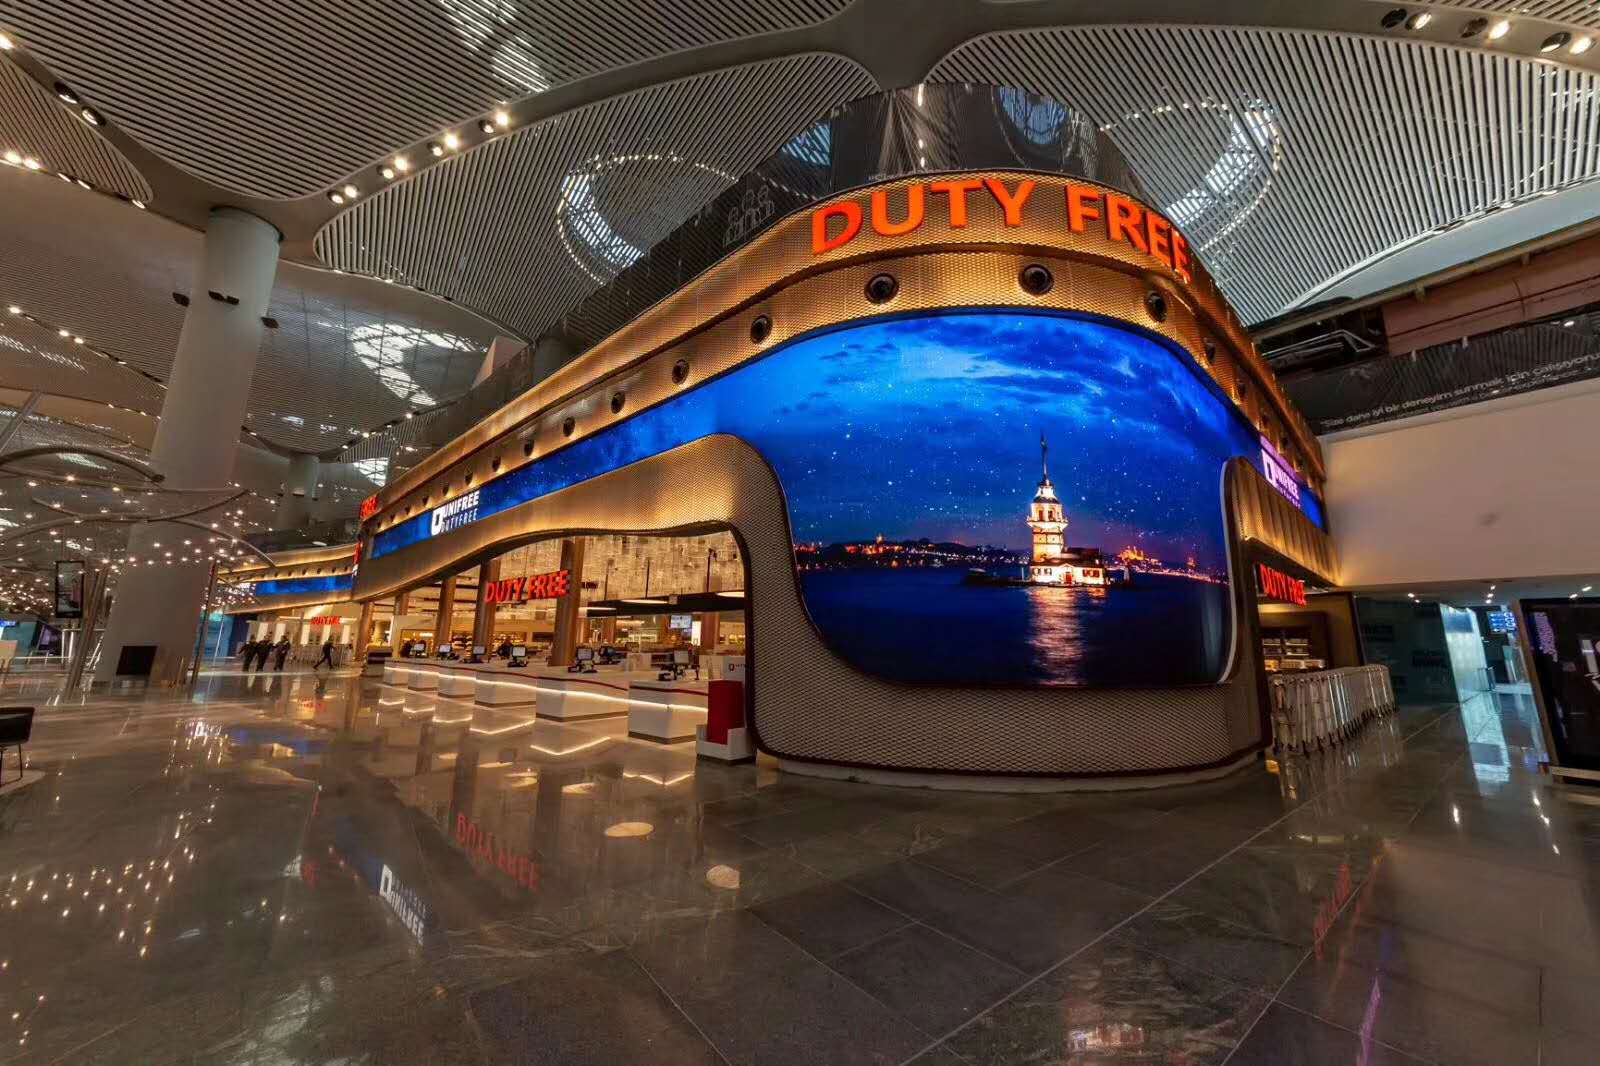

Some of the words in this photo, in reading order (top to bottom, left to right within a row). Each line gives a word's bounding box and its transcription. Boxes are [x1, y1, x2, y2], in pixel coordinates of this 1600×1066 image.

[811, 177, 1036, 256] DUTY
[1063, 182, 1192, 286] FREE
[444, 490, 480, 517] UNIFREE
[484, 577, 527, 604] DUTY
[528, 569, 569, 601] FREE
[1260, 563, 1288, 600] DUTY
